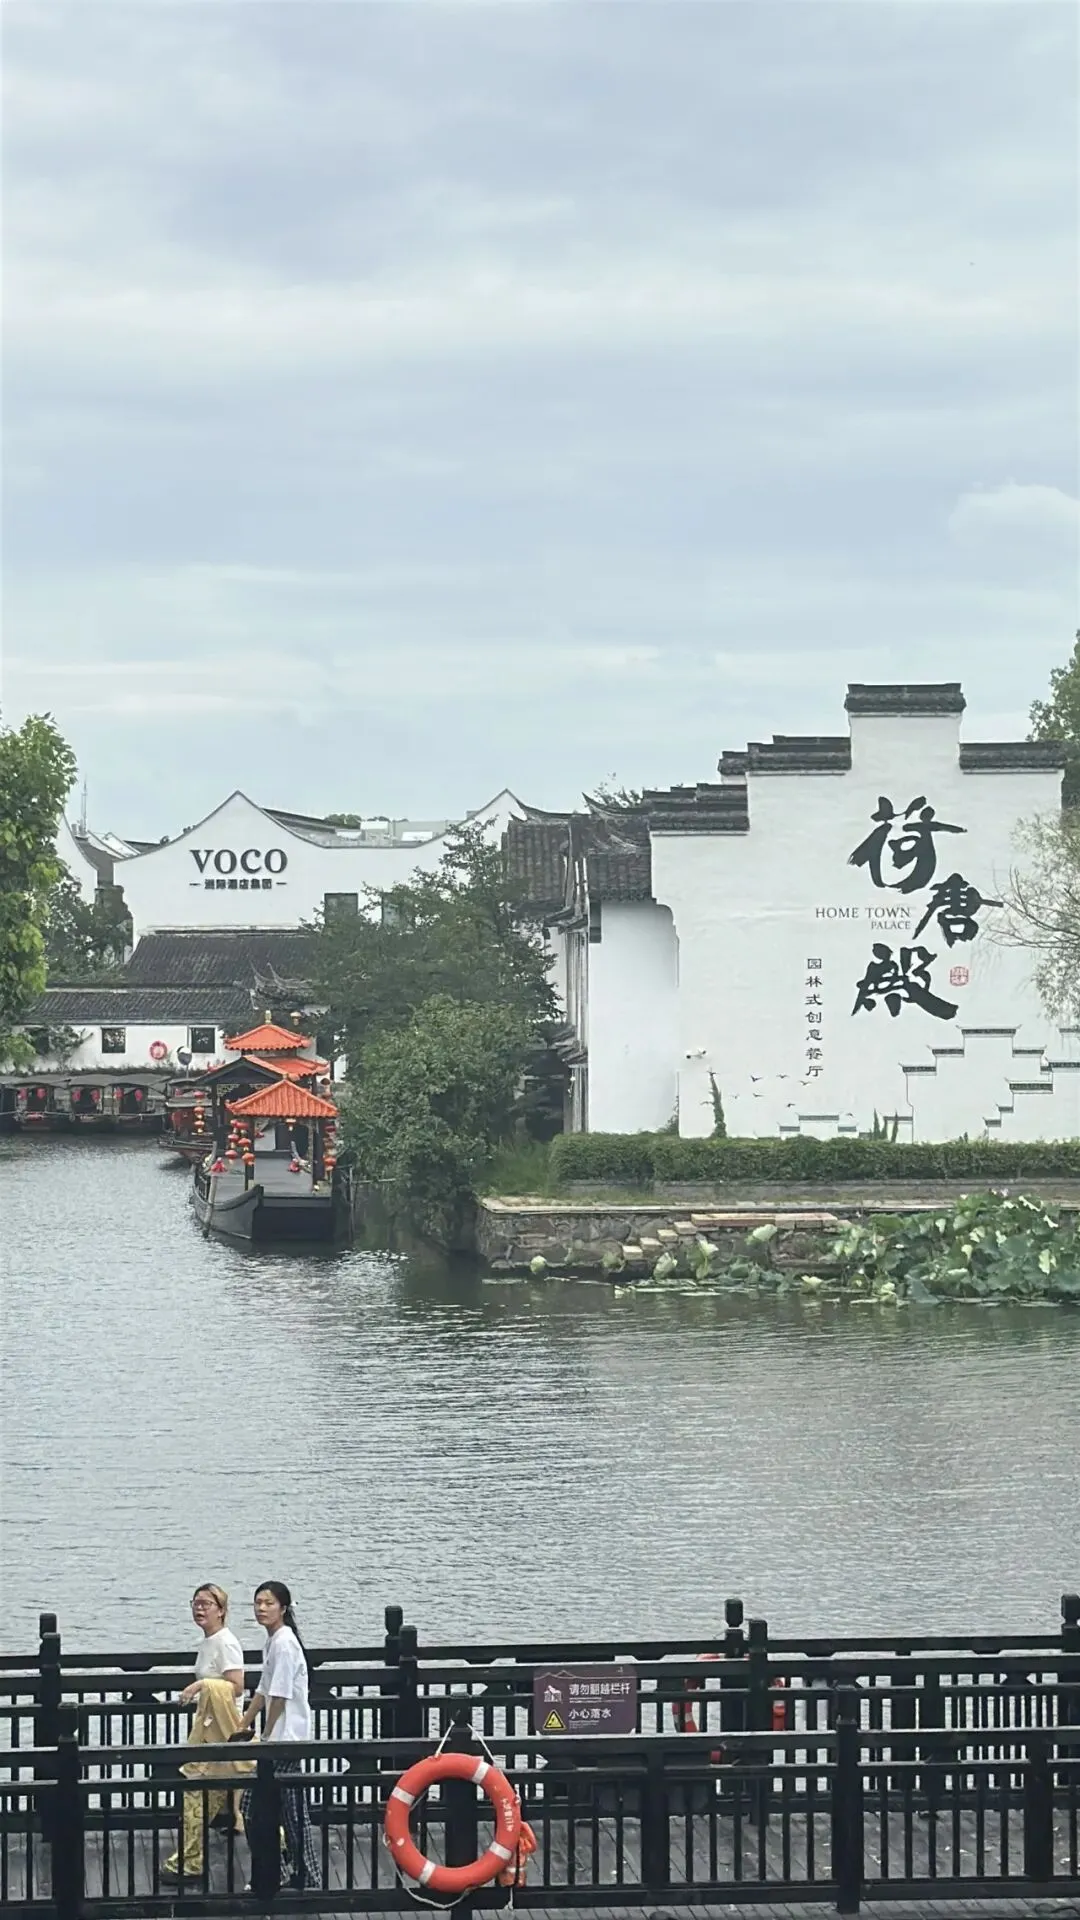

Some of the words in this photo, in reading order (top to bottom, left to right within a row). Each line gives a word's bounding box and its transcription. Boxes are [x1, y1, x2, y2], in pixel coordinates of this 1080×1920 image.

[815, 906, 859, 919] HOME
[864, 906, 911, 919] TOWN
[847, 796, 1003, 1020] 荷唐殿
[870, 920, 911, 930] PALACE
[805, 958, 824, 1077] 园林式创意餐厅
[569, 1683, 631, 1696] 请勿翻越栏杆
[568, 1708, 612, 1719] 小心落水
